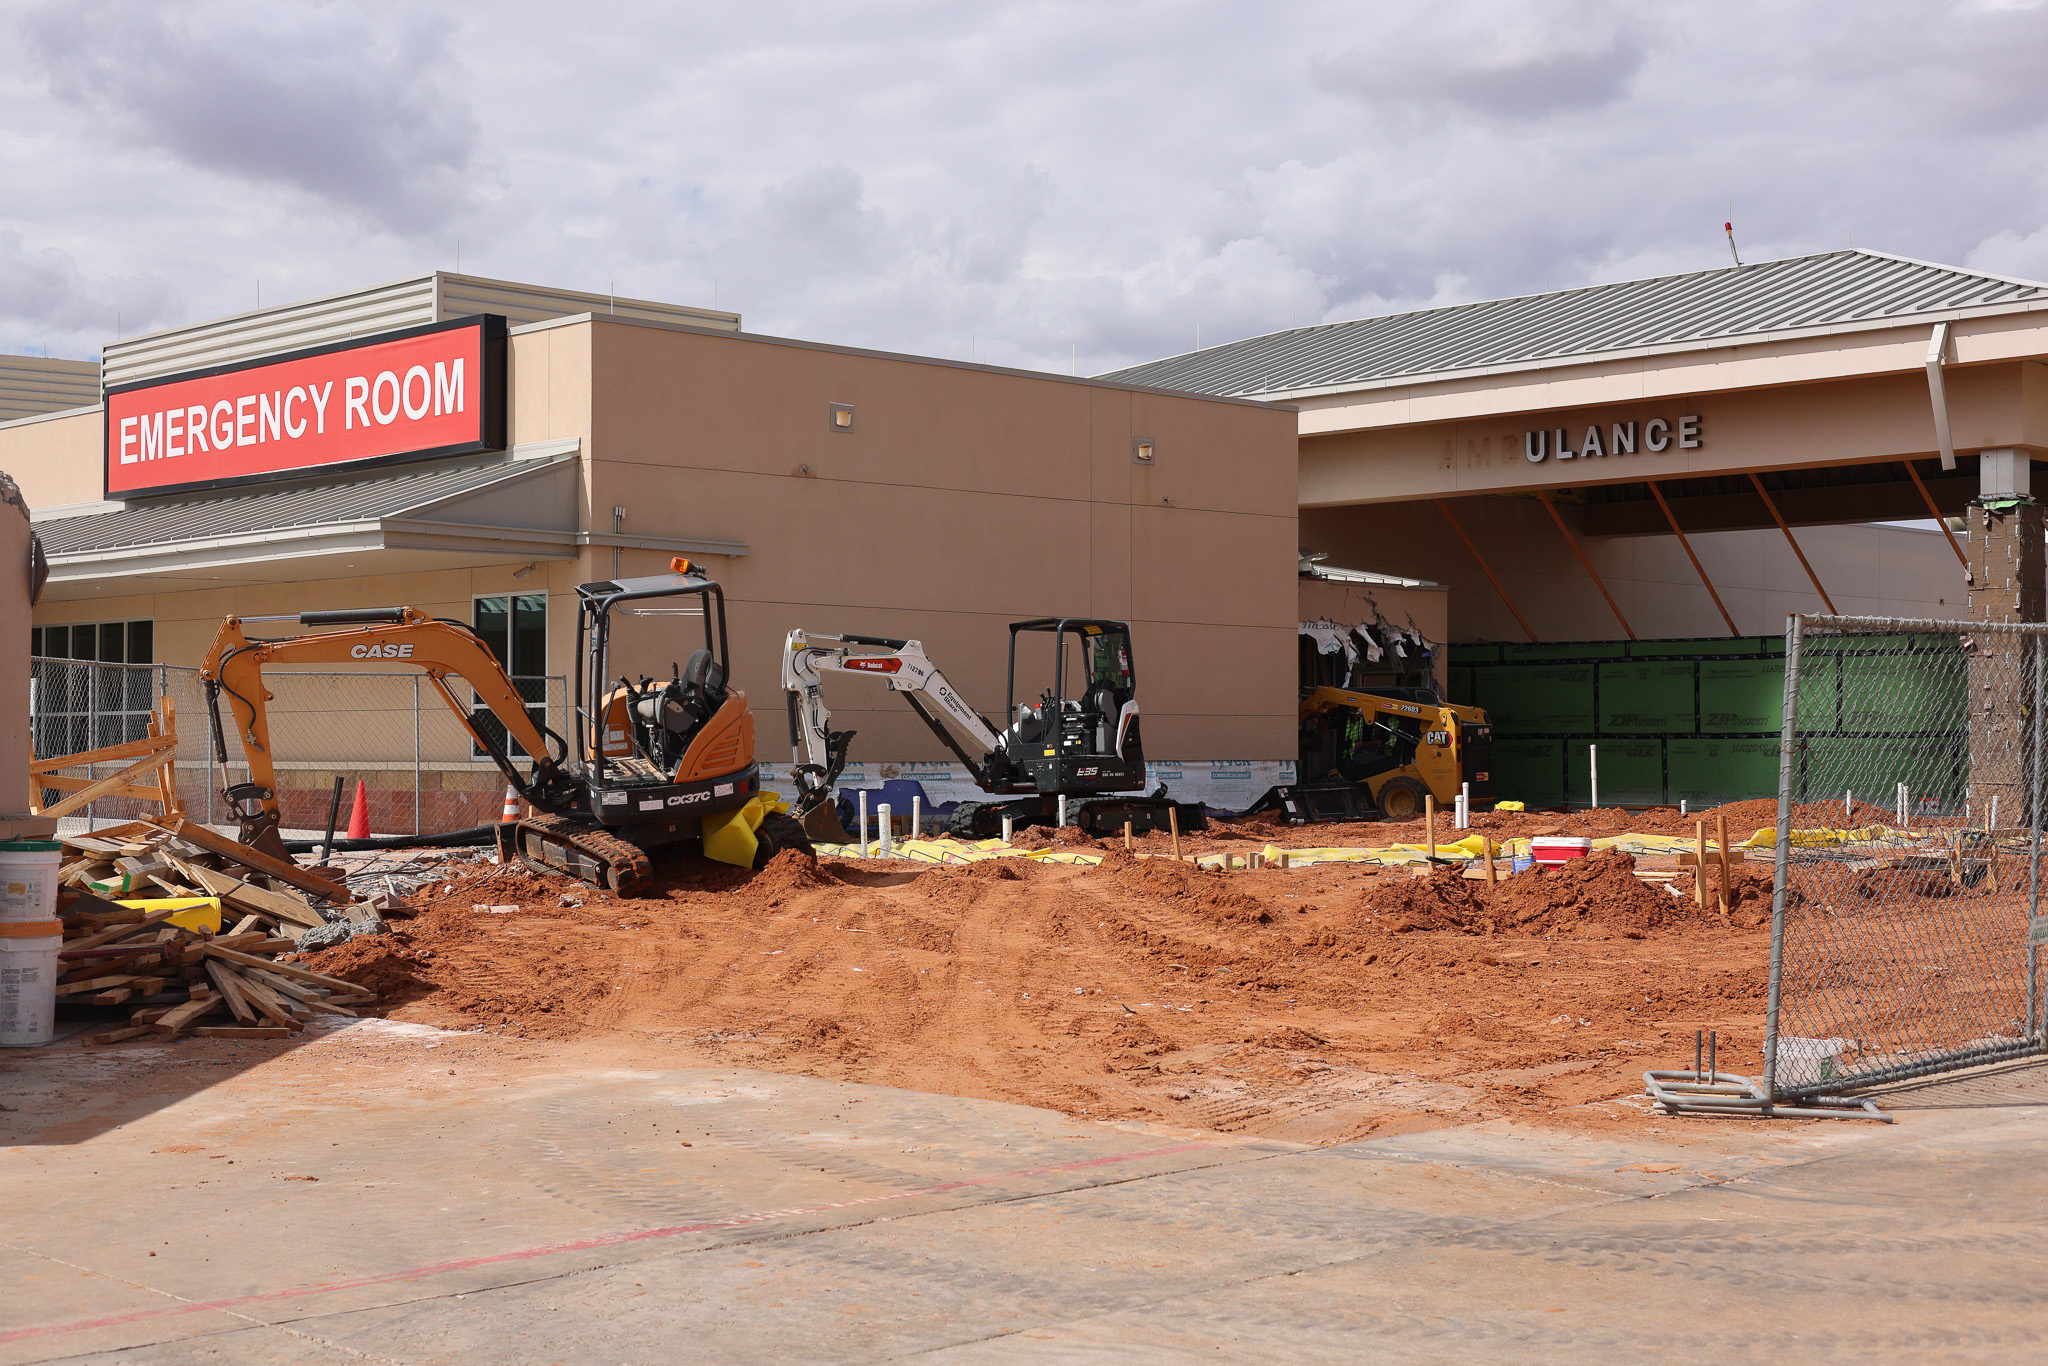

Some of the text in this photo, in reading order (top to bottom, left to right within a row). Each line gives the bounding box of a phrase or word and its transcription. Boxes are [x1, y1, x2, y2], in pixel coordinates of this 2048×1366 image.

[120, 357, 464, 465] EMERGENCY ROOM
[350, 643, 415, 658] CASE
[944, 696, 957, 712] Share
[947, 692, 972, 720] Equipment
[1427, 731, 1447, 745] CAT
[1076, 766, 1098, 776] E35
[667, 791, 711, 806] CX37C
